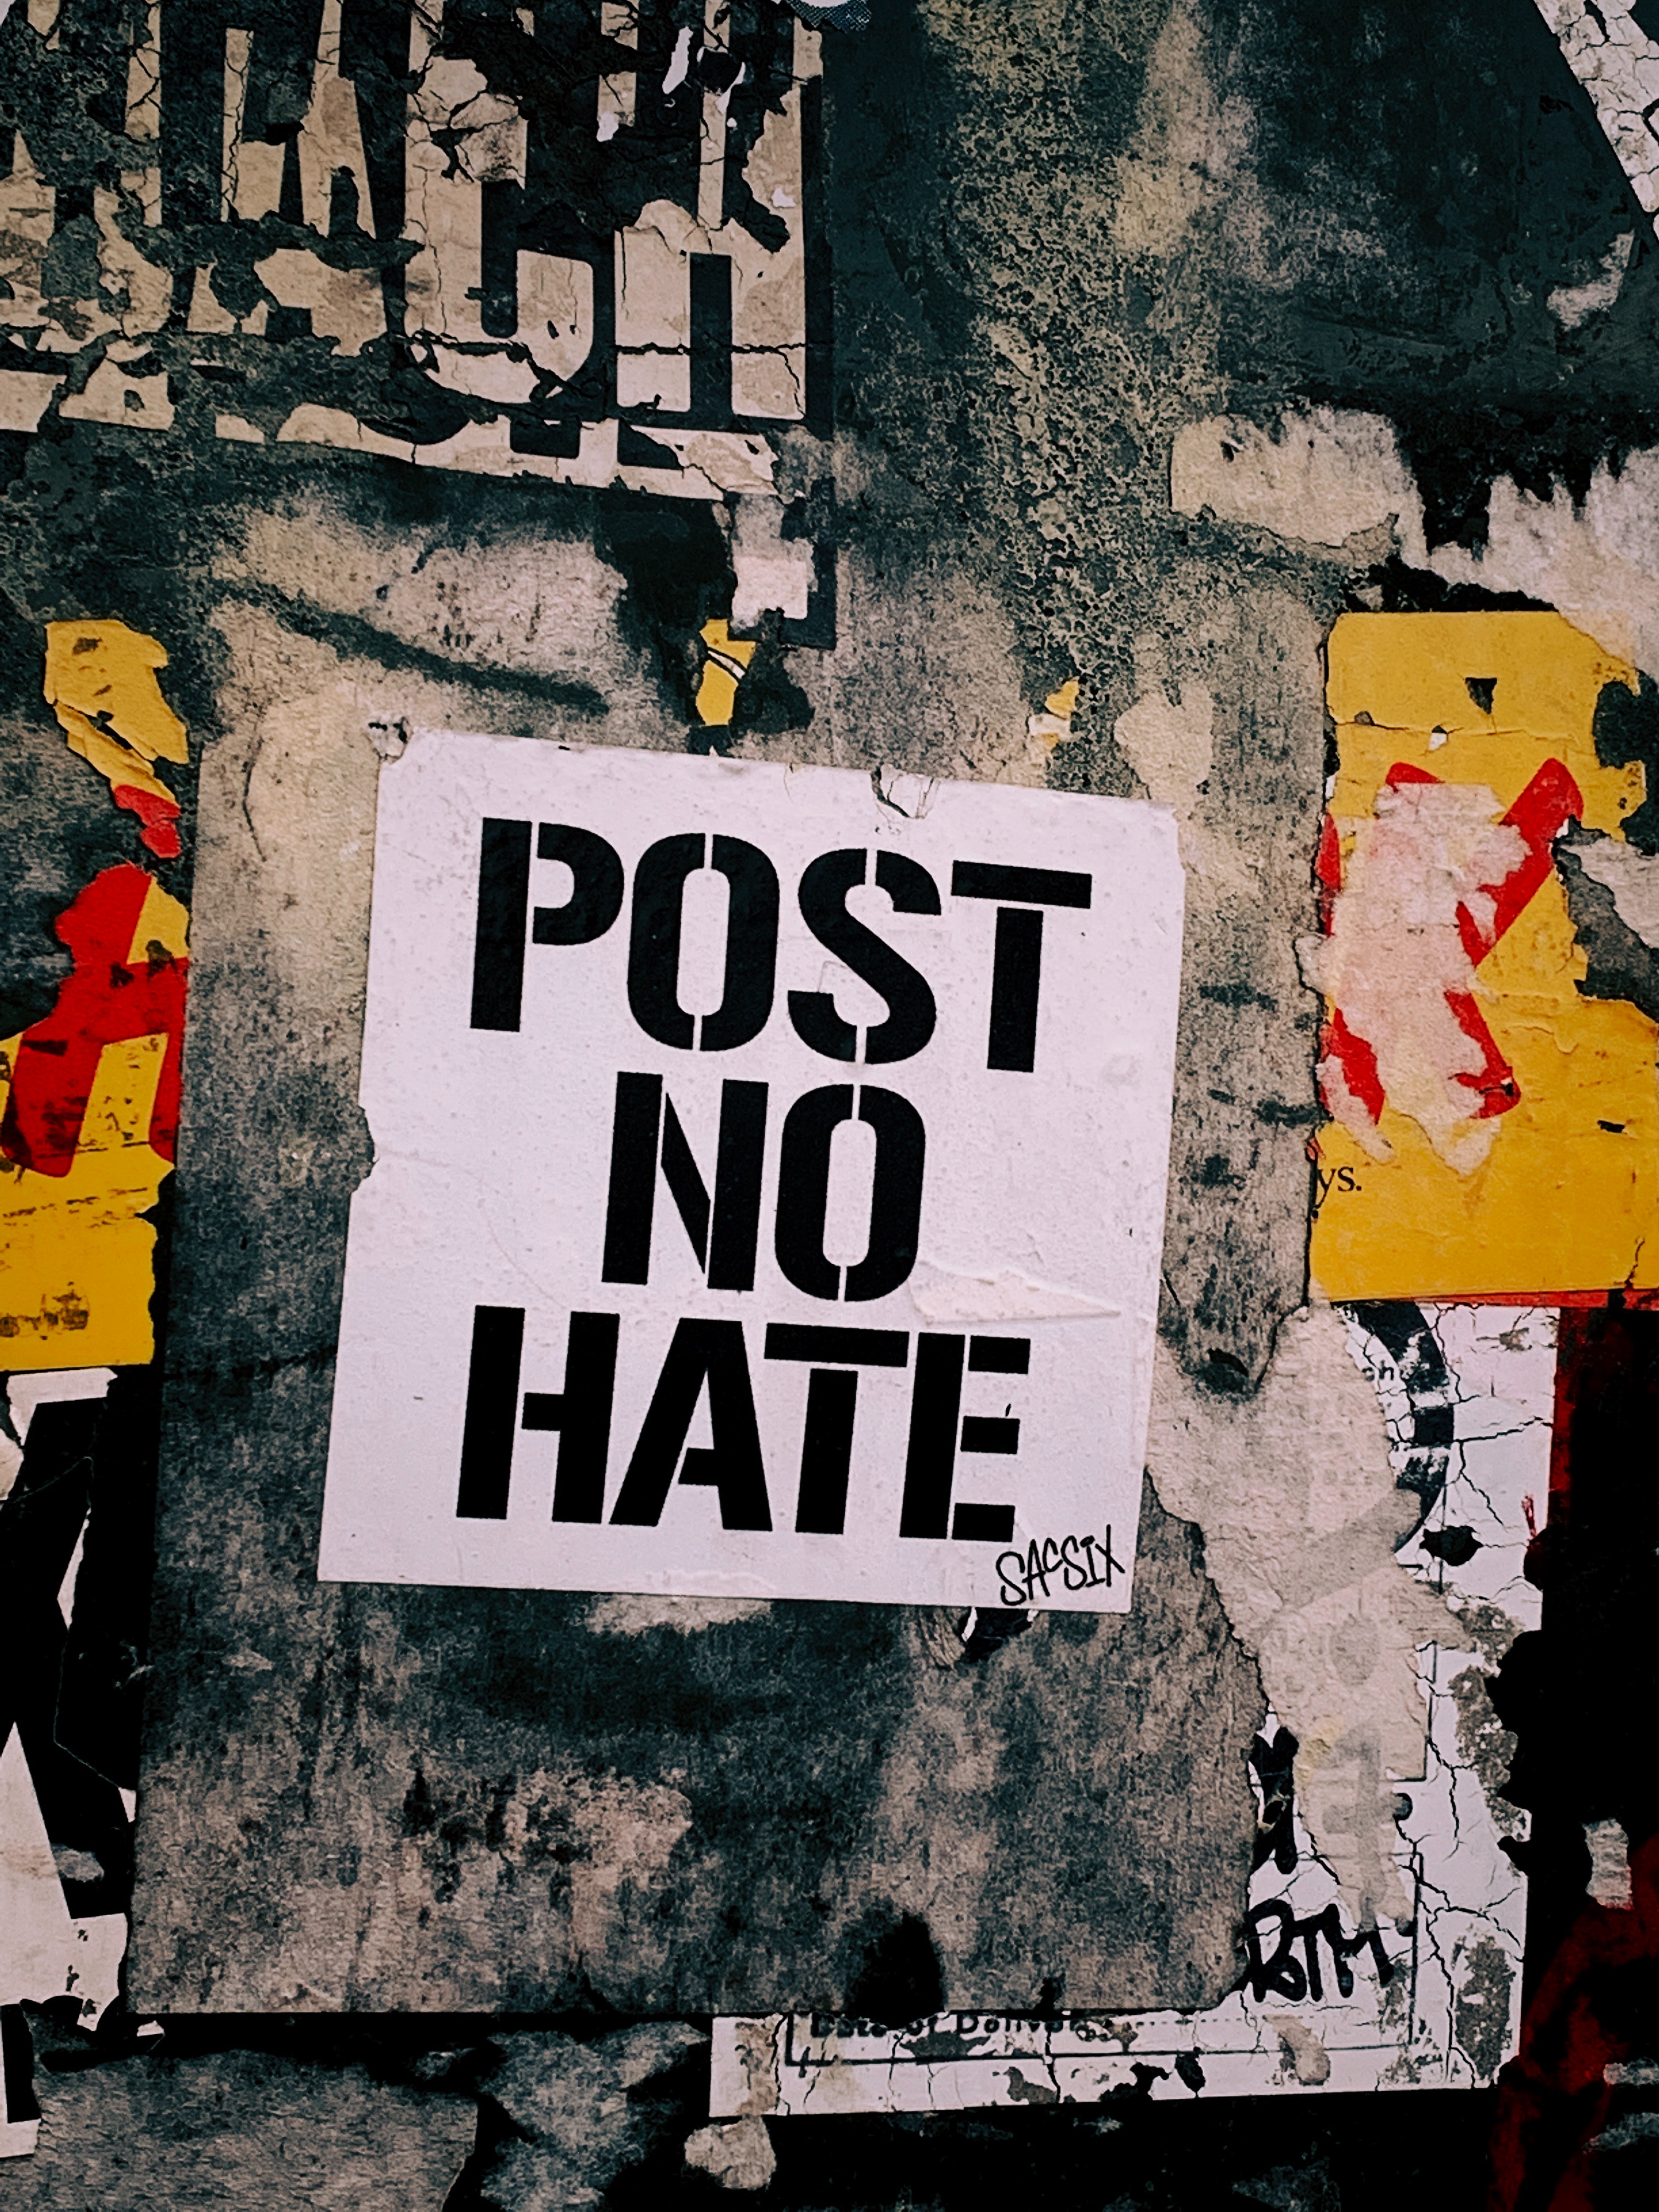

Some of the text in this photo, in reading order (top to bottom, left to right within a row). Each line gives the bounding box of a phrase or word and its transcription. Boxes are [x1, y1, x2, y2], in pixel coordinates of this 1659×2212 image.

[470, 817, 1092, 1073] POST
[602, 1071, 926, 1302] NO
[456, 1305, 1031, 1543] HATE
